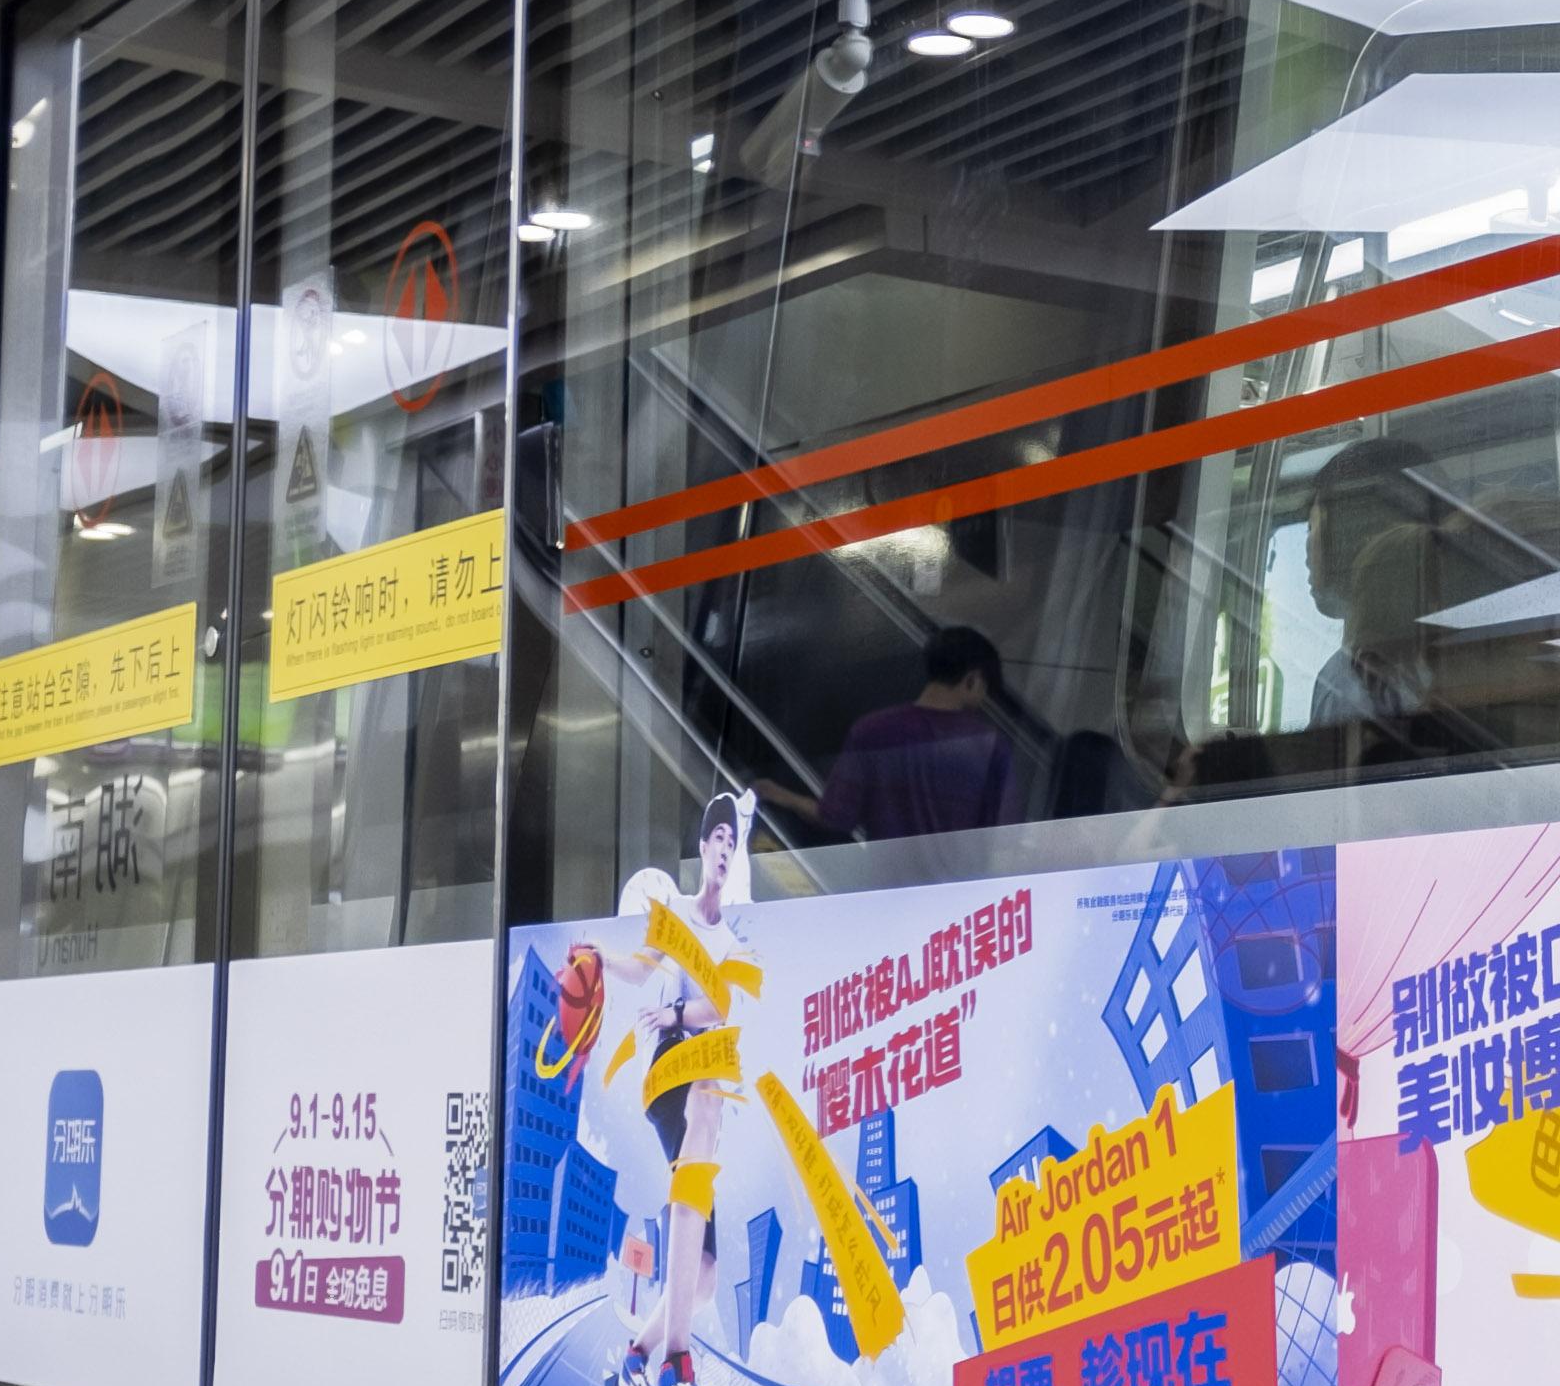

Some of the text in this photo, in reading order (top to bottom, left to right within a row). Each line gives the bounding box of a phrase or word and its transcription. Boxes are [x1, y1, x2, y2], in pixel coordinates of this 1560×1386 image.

[801, 888, 1033, 1058] 别做被AJ耽误的
[51, 1116, 97, 1166] 分期乐
[289, 1092, 378, 1141] 9.1-9.15
[264, 1165, 403, 1247] 分期购物节
[998, 1097, 1177, 1244] Air Jordan 1
[269, 1248, 391, 1313] 9.1日 全场免息
